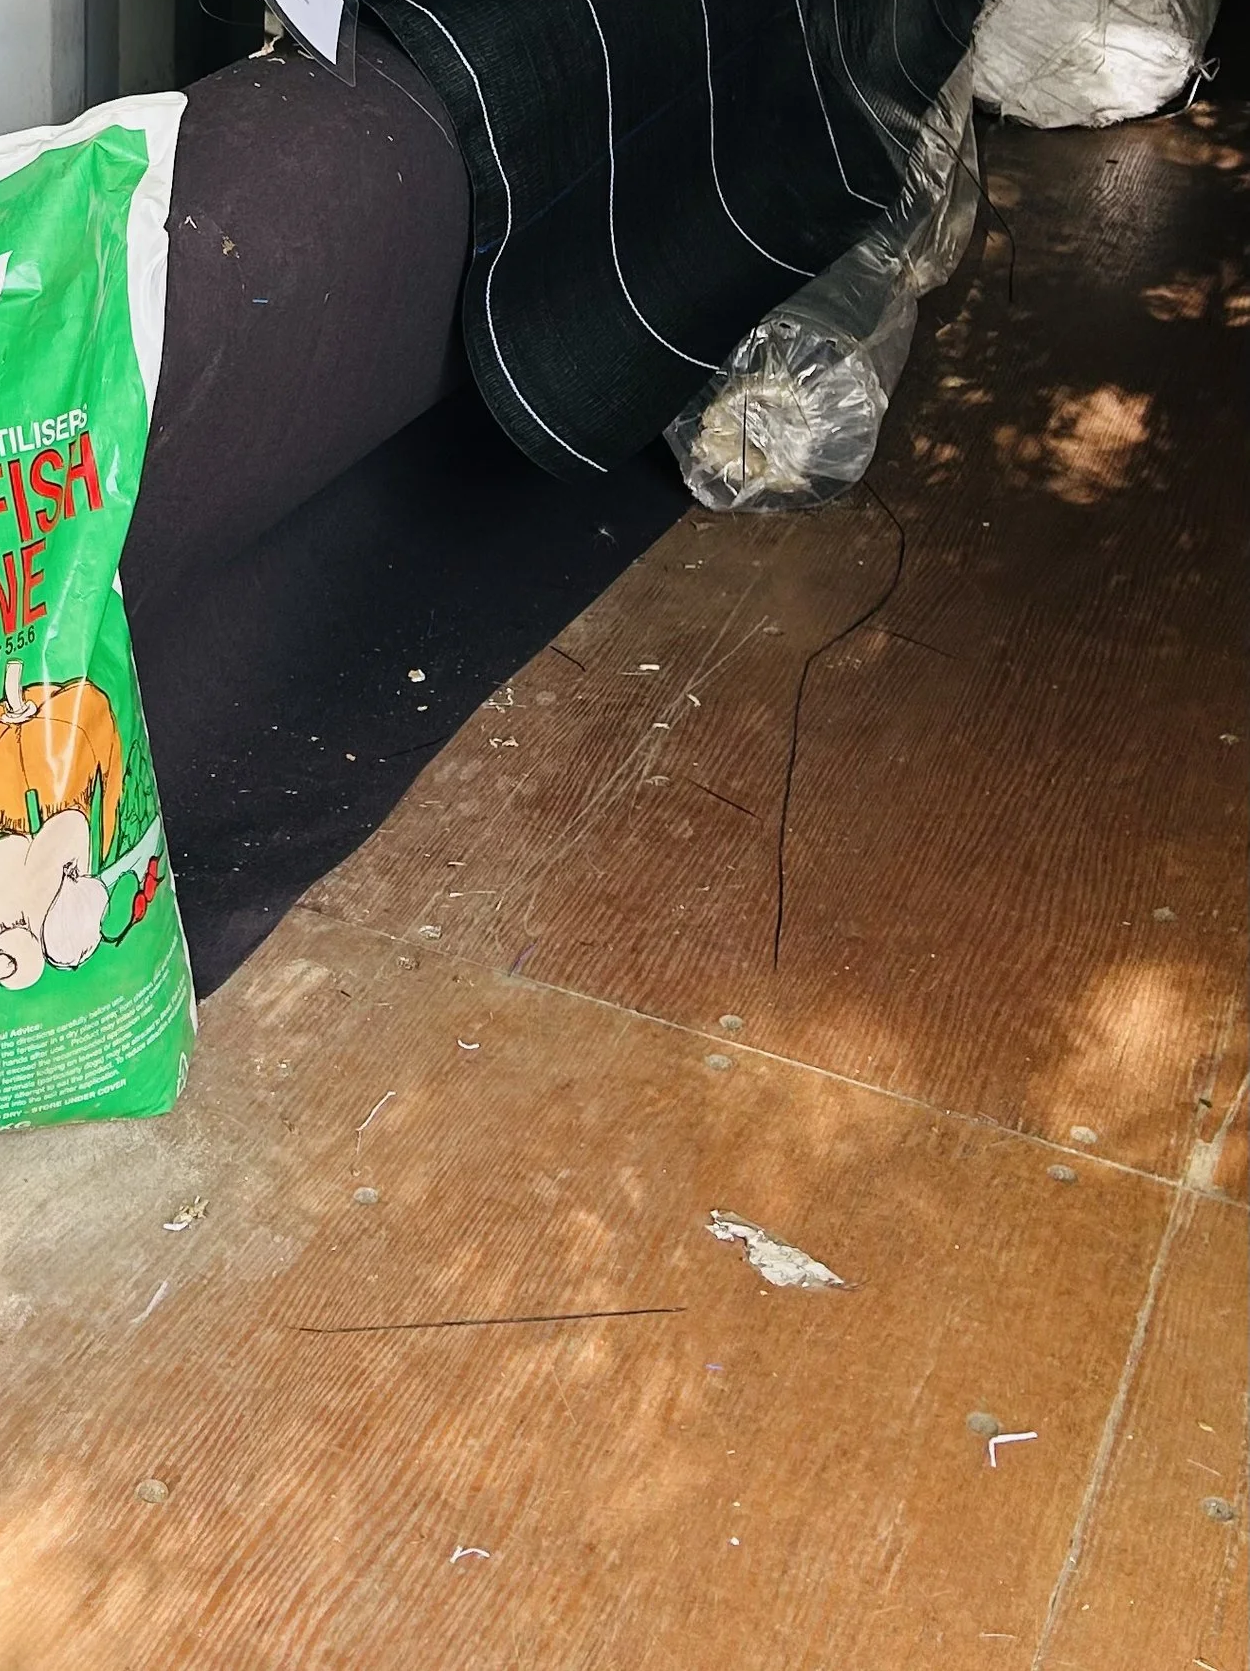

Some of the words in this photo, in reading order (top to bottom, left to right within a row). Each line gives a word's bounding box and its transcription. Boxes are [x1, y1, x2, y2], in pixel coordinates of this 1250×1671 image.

[0, 1041, 15, 1050] the
[16, 1028, 56, 1046] directions
[0, 1050, 15, 1059] the
[65, 1030, 79, 1040] dry
[2, 1056, 29, 1068] hands
[30, 1050, 48, 1061] after
[5, 1062, 38, 1076] exceed
[38, 1058, 52, 1068] the
[2, 1110, 23, 1120] DRY
[31, 1099, 63, 1114] STORE
[63, 1090, 97, 1107] UNDER
[96, 1077, 128, 1097] COVER
[11, 1098, 28, 1108] into
[28, 1096, 43, 1105] the
